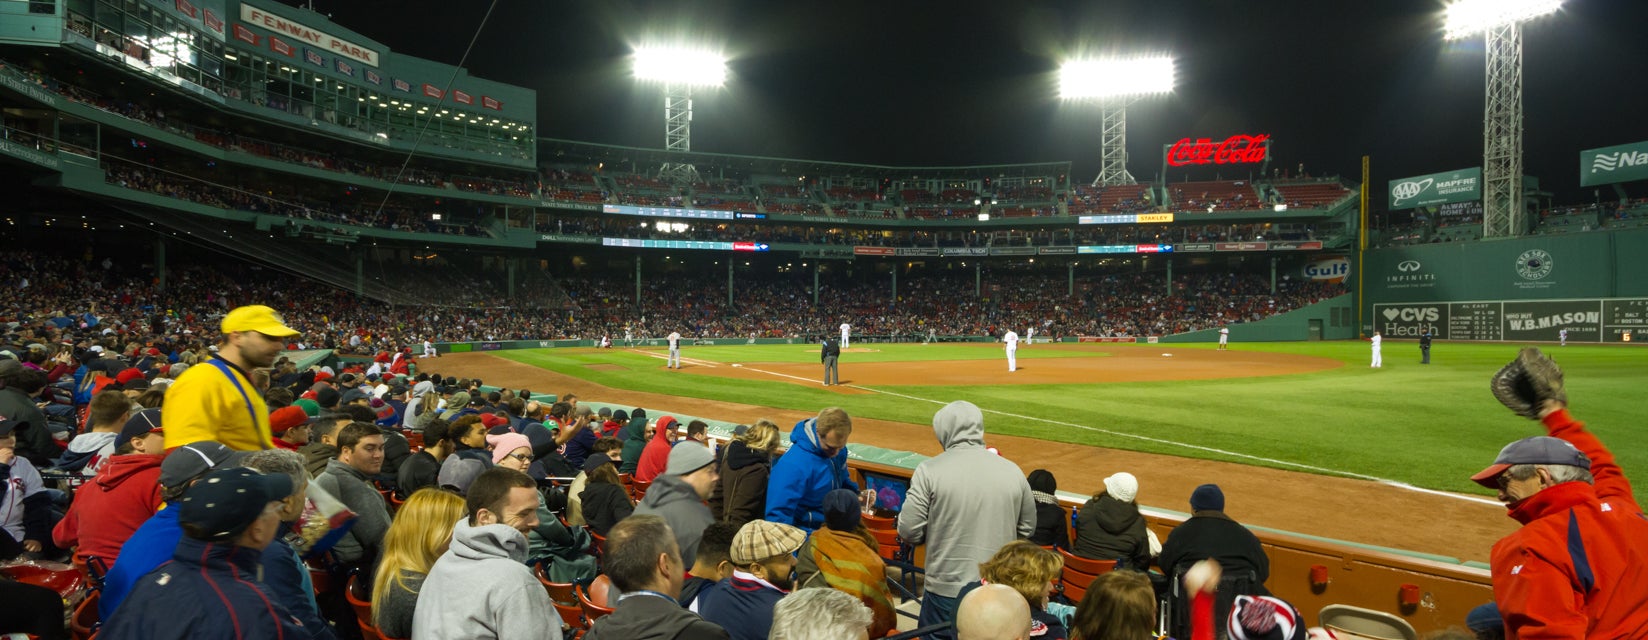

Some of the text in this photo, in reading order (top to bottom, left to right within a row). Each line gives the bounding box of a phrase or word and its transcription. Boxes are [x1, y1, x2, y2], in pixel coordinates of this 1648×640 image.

[251, 10, 372, 62] FENWAY PARK
[1436, 177, 1476, 188] MAPFRE
[1395, 182, 1419, 198] AAA
[1438, 186, 1474, 195] INSURANCE
[1440, 208, 1463, 216] HOME
[1305, 263, 1347, 276] Gulf
[1387, 273, 1435, 282] INFINITI
[1401, 307, 1439, 321] CVS
[1384, 322, 1439, 336] Healh
[1622, 333, 1631, 342] 6
